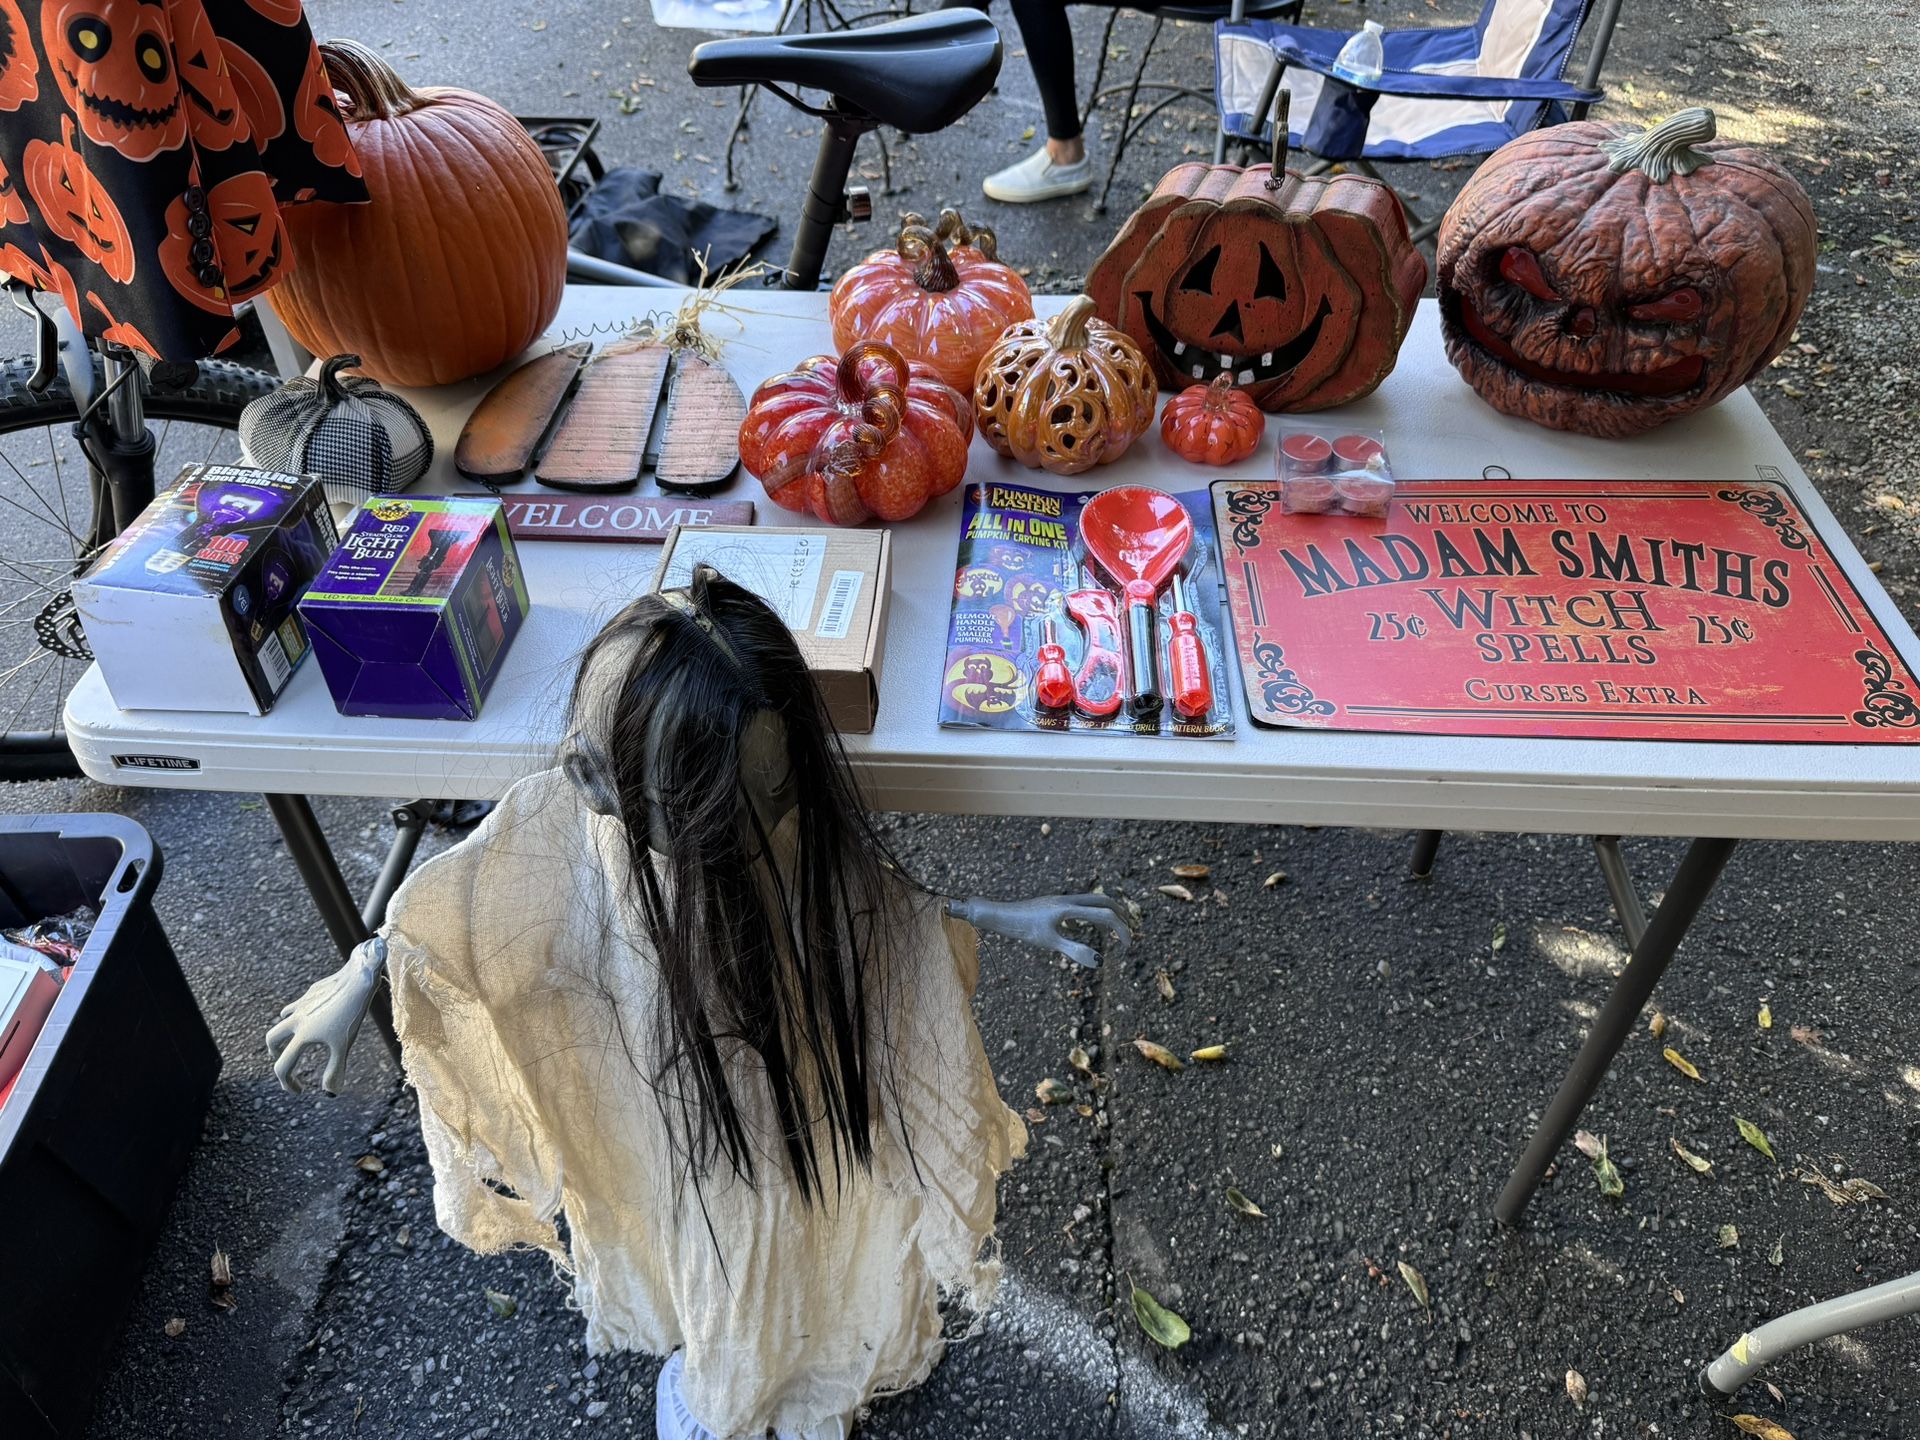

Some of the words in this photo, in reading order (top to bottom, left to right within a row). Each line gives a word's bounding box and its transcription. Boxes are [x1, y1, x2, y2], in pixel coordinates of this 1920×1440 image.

[201, 474, 237, 482] Spot
[235, 476, 271, 486] Bulb
[991, 499, 1061, 516] MASTERS
[993, 487, 1060, 509] PUMPKIN
[1404, 503, 1558, 523] WELCOME
[1565, 504, 1607, 523] TO
[381, 523, 410, 533] RED
[968, 512, 1003, 530] ALL
[1008, 518, 1025, 533] IN
[1029, 518, 1067, 540] ONE
[207, 535, 249, 554] 100
[342, 533, 404, 550] LIGHT
[965, 530, 1010, 541] PUMPKIN
[1013, 534, 1051, 547] CARVING
[1053, 540, 1069, 550] KIT
[195, 550, 241, 565] WATTS
[352, 547, 396, 560] BULB
[1278, 527, 1541, 598] MADAM
[1551, 529, 1791, 608] SMITHS
[1418, 588, 1667, 632] WITCH
[1366, 612, 1427, 641] 25¢
[1689, 615, 1755, 644] 25¢
[1474, 633, 1658, 664] SPELLS
[1465, 679, 1589, 703] CURSES
[1601, 682, 1708, 705] EXTRA
[1035, 717, 1057, 727] SAWS
[124, 757, 192, 768] LIFETIME
